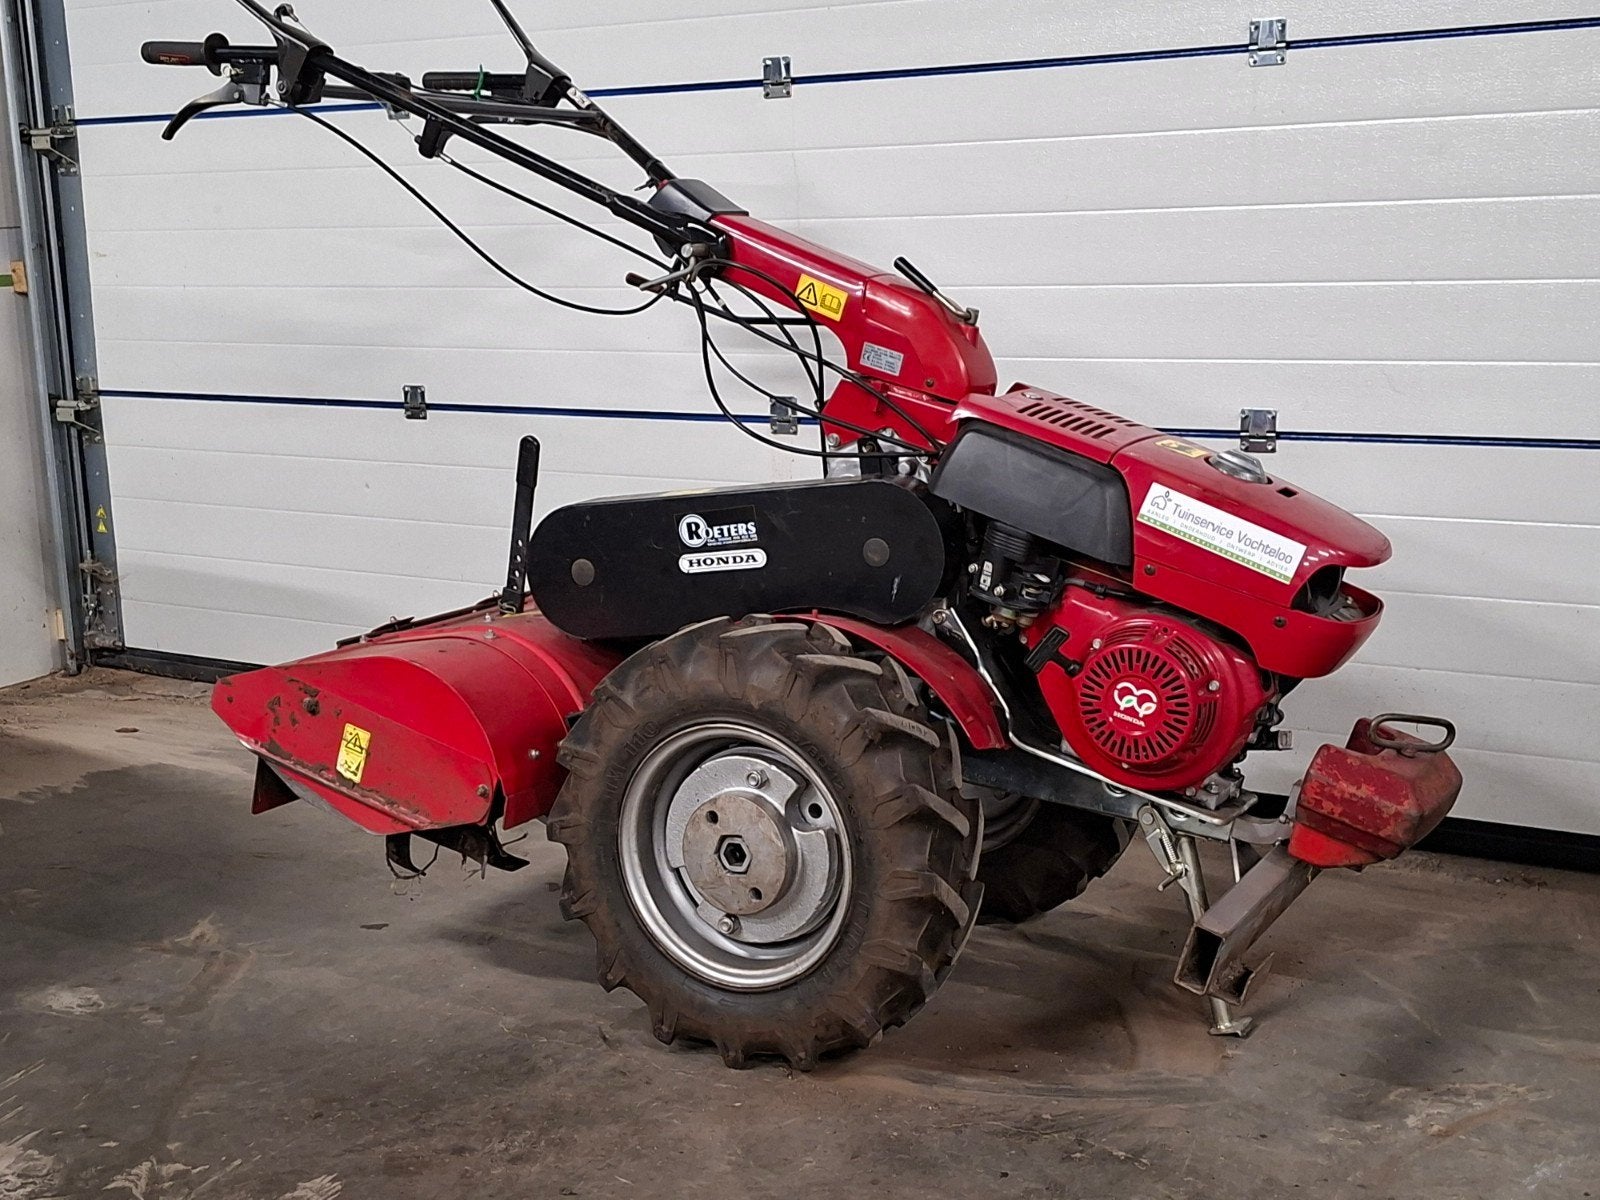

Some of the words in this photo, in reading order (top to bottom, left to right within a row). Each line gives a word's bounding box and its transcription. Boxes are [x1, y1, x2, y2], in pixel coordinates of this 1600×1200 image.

[686, 522, 756, 540] ROETERS
[1173, 503, 1234, 539] Tuinservice
[1237, 530, 1293, 565] Vochteloo
[687, 554, 758, 568] HONDA
[1113, 711, 1145, 727] HONDA
